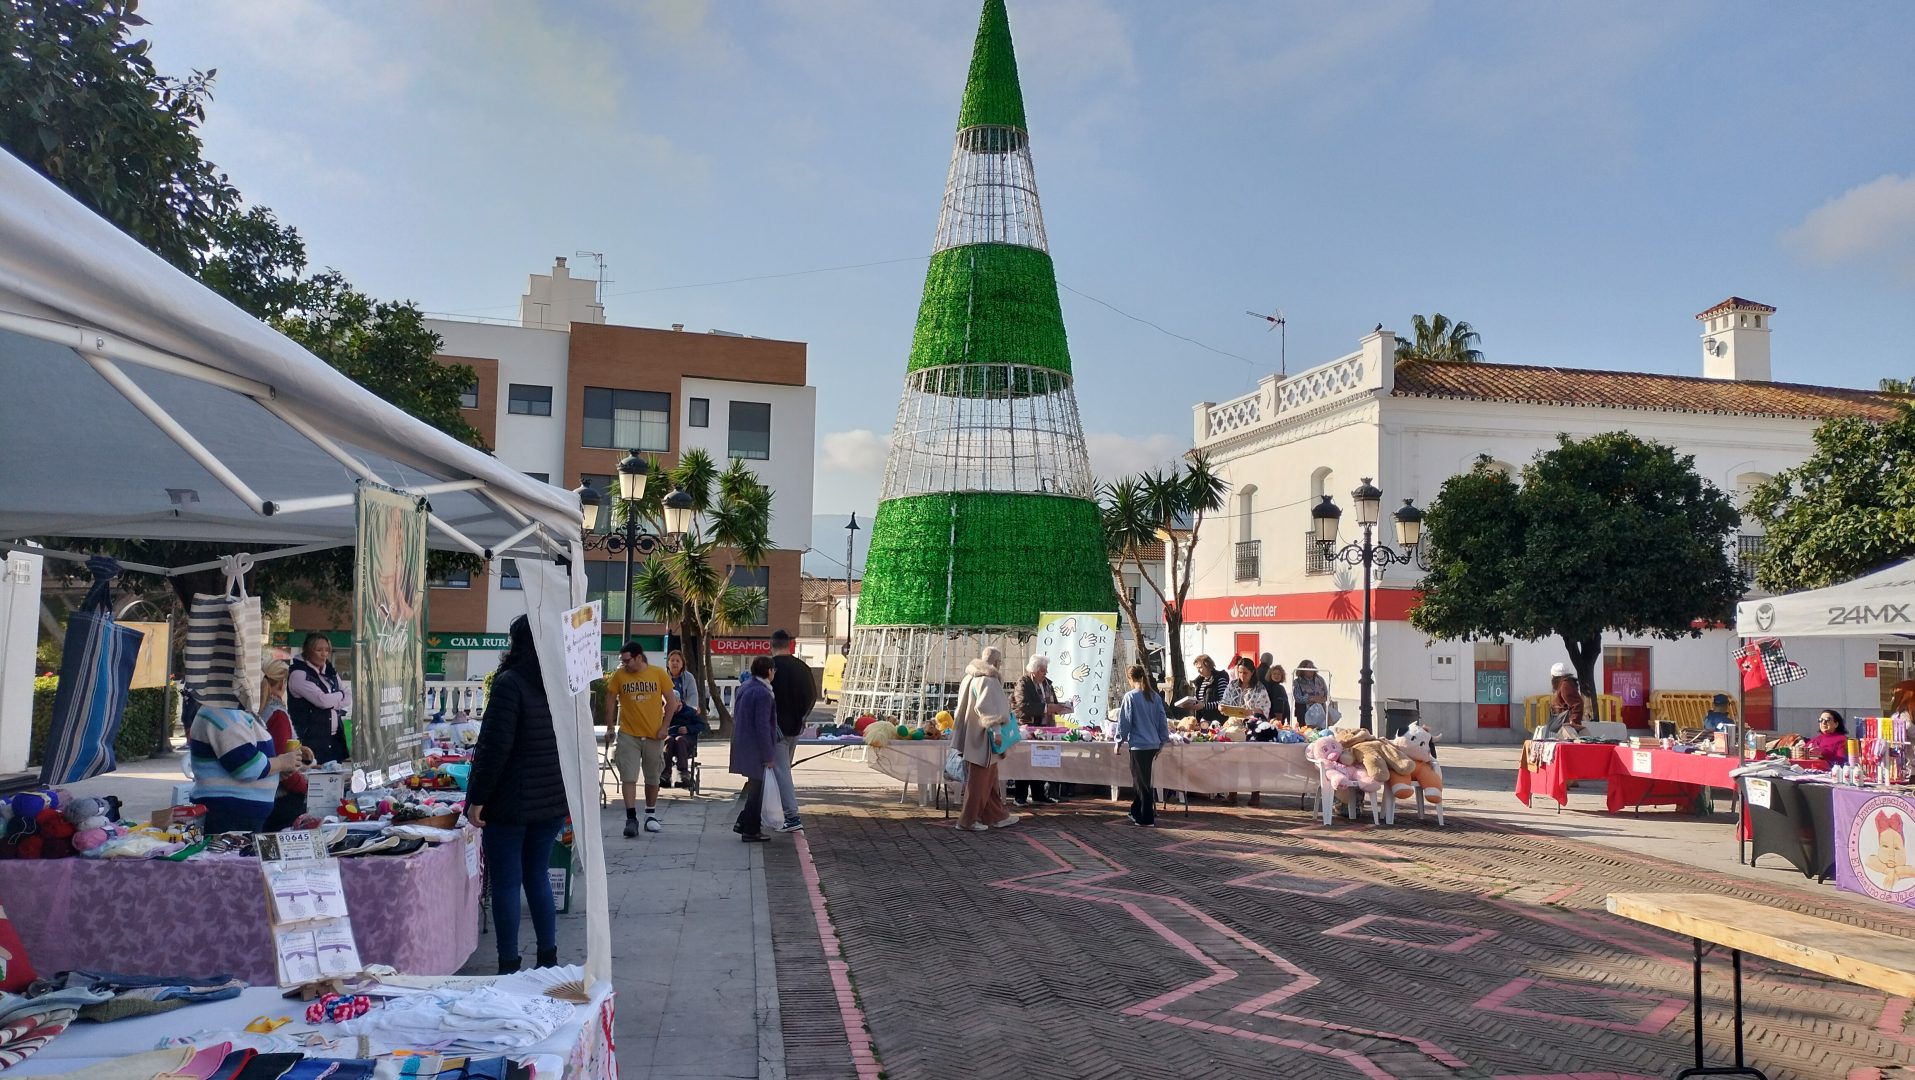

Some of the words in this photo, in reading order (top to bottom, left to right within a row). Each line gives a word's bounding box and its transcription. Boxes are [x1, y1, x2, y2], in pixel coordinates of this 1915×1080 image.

[1240, 602, 1278, 618] Santander
[1828, 604, 1912, 625] 24MX
[450, 638, 479, 647] CAJA
[482, 638, 512, 647] RURA
[717, 641, 771, 650] DREAMHO
[1088, 623, 1109, 728] ORFANATOS
[622, 681, 658, 695] PASADENA
[278, 833, 310, 843] 80645
[1895, 890, 1915, 902] Vale
